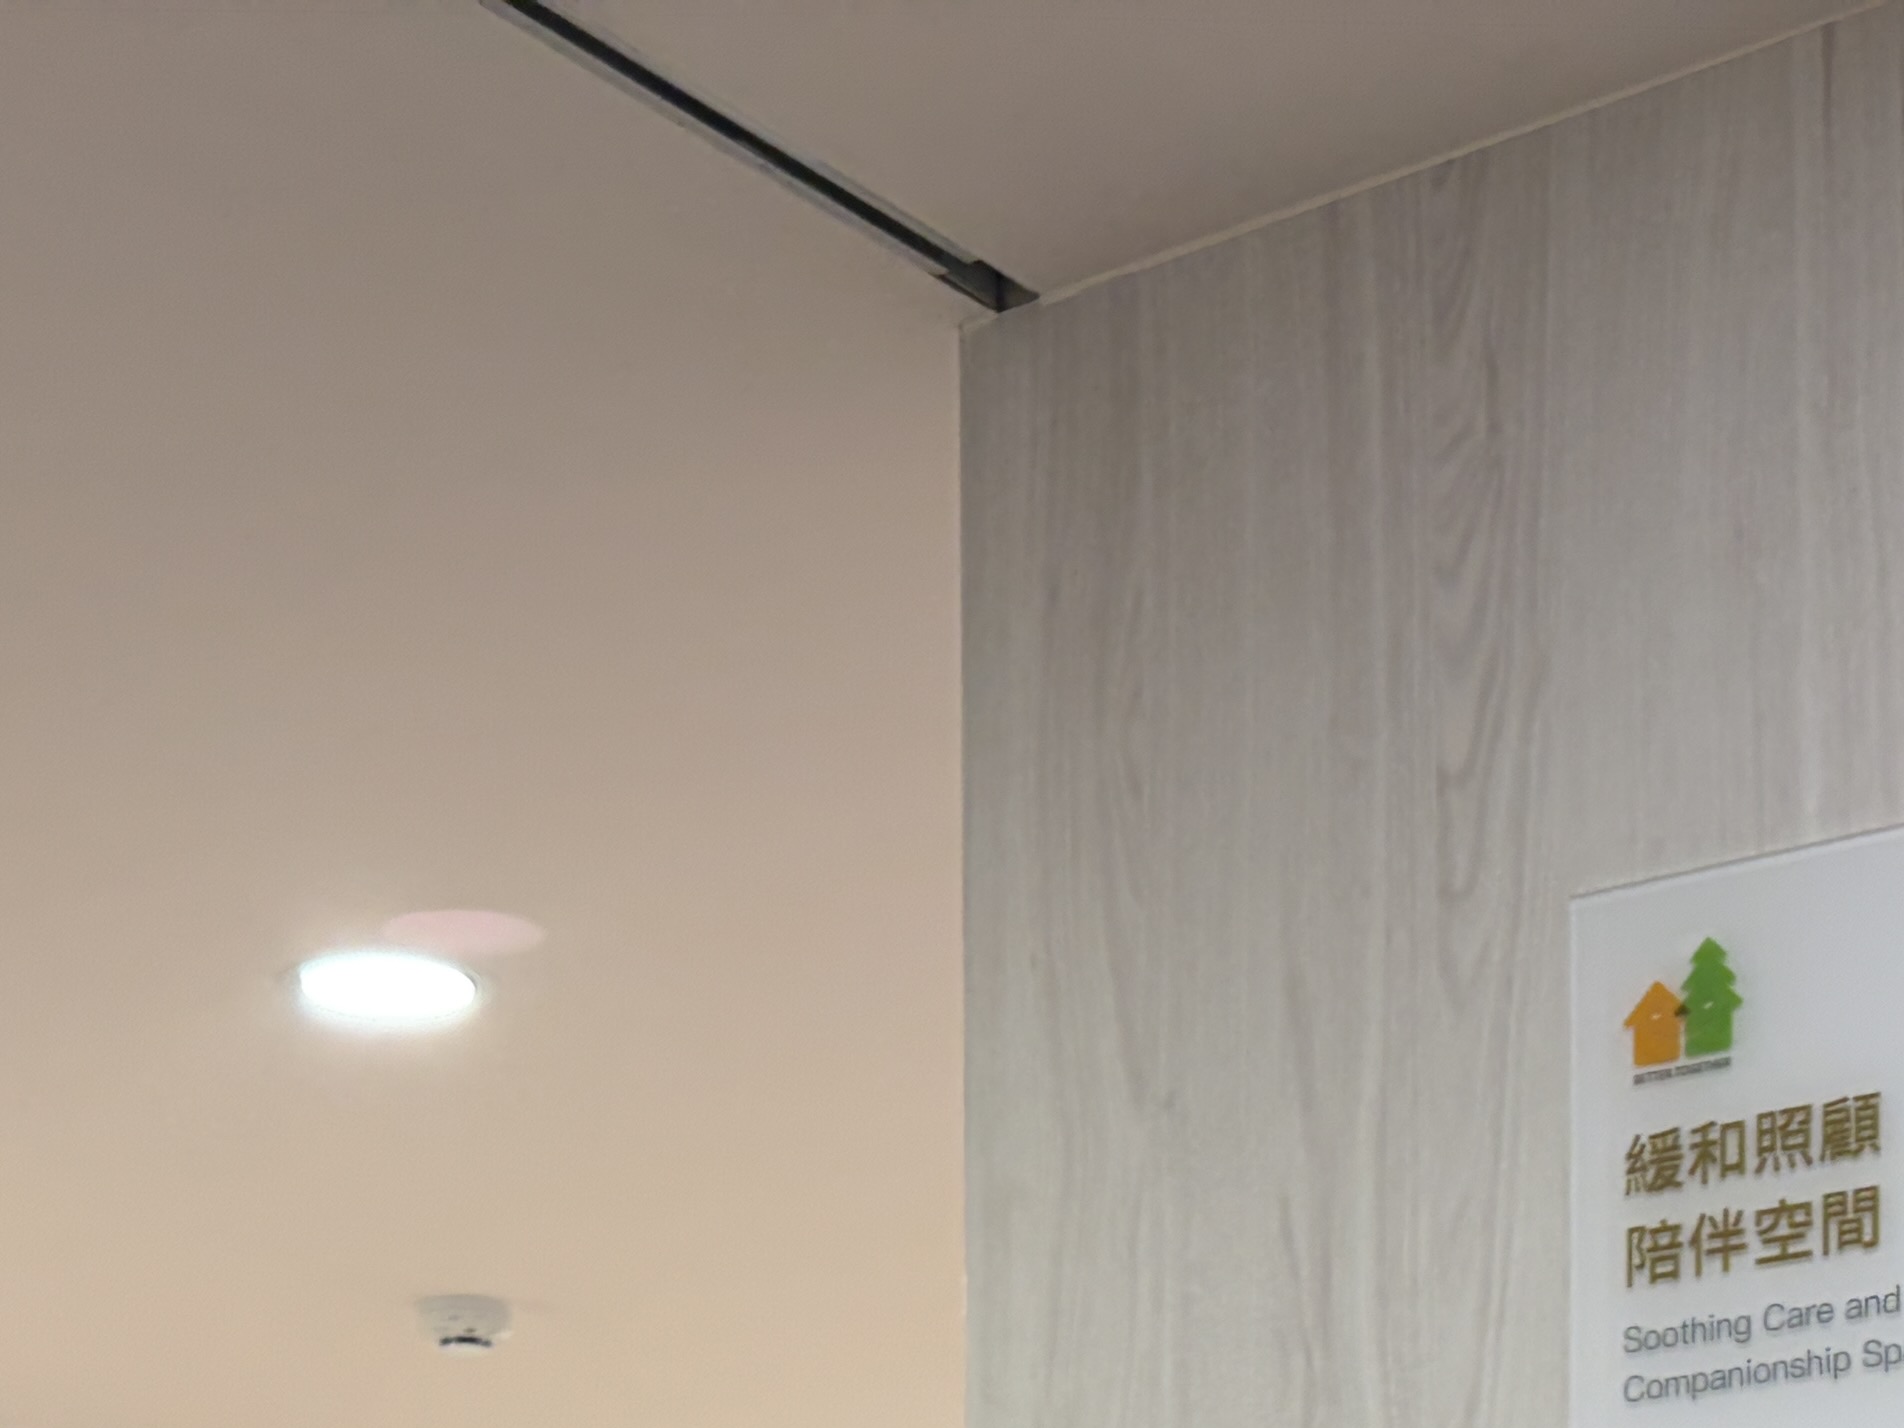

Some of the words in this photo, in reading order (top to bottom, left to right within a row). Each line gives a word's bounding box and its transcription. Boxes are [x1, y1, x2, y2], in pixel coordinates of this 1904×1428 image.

[1624, 1091, 1883, 1196] 緩和照顧
[1626, 1185, 1882, 1288] 陪伴空間
[1623, 1310, 1752, 1354] Soothing
[1764, 1297, 1835, 1333] Care
[1845, 1284, 1902, 1318] and
[1623, 1345, 1852, 1404] Companionship
